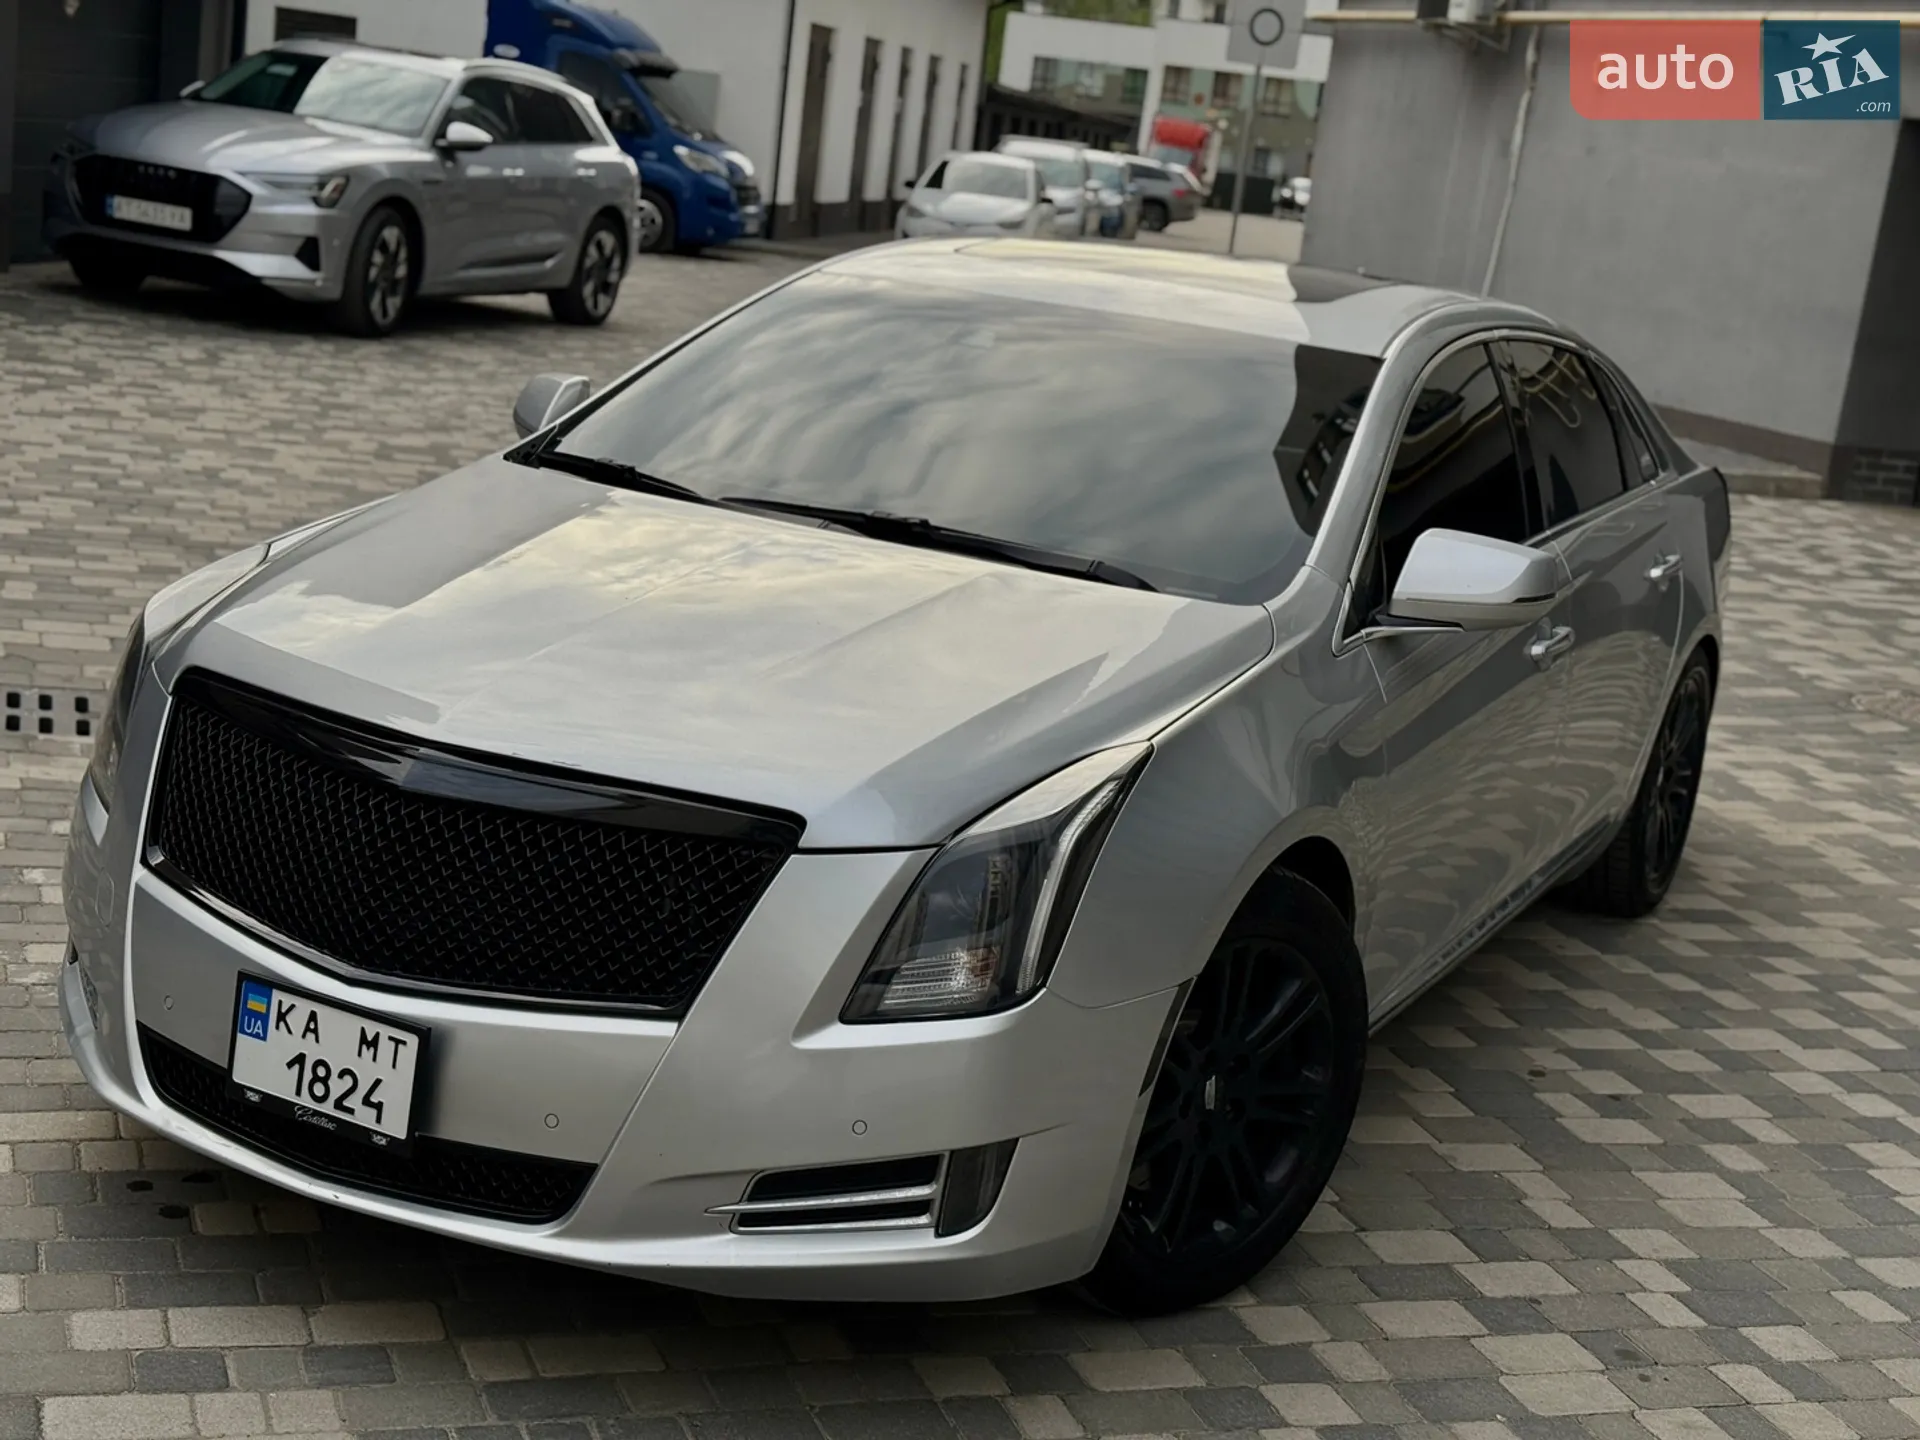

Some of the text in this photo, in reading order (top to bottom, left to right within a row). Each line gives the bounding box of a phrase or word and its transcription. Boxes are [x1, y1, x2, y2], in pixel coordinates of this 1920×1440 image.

[244, 1015, 264, 1037] UA
[275, 999, 407, 1069] KA MT
[286, 1052, 384, 1124] 1824
